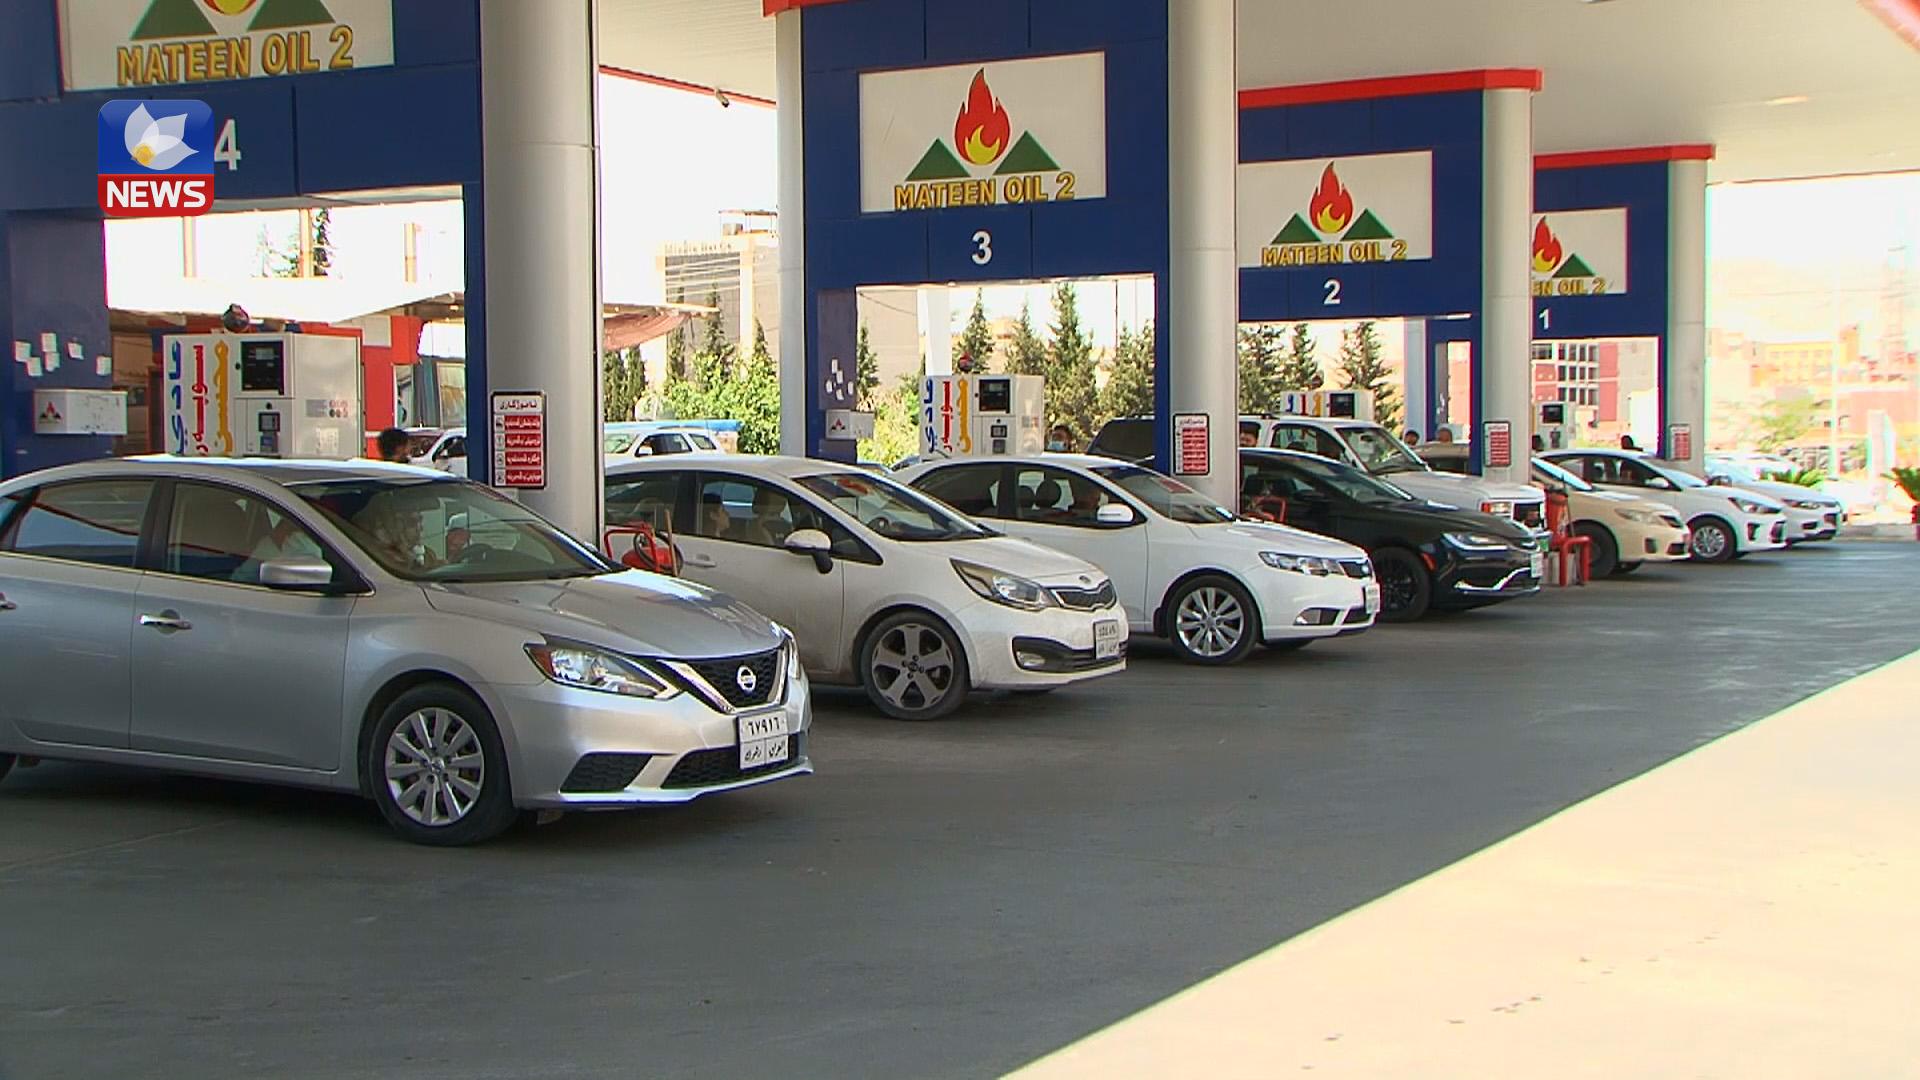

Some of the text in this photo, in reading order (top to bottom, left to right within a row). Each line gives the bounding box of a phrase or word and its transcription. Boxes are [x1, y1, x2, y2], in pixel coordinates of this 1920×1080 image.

[116, 25, 354, 86] MATEEN OIL 2
[214, 118, 242, 171] 4
[894, 172, 1076, 211] MATEEN OIL 2
[971, 230, 993, 265] 3
[1261, 239, 1409, 267] MATEEN OIL 2
[1323, 279, 1342, 305] 2
[1558, 278, 1588, 295] OIL
[1592, 277, 1607, 295] 2
[1539, 308, 1550, 330] 1
[747, 716, 780, 736] ٦٧٩١٦
